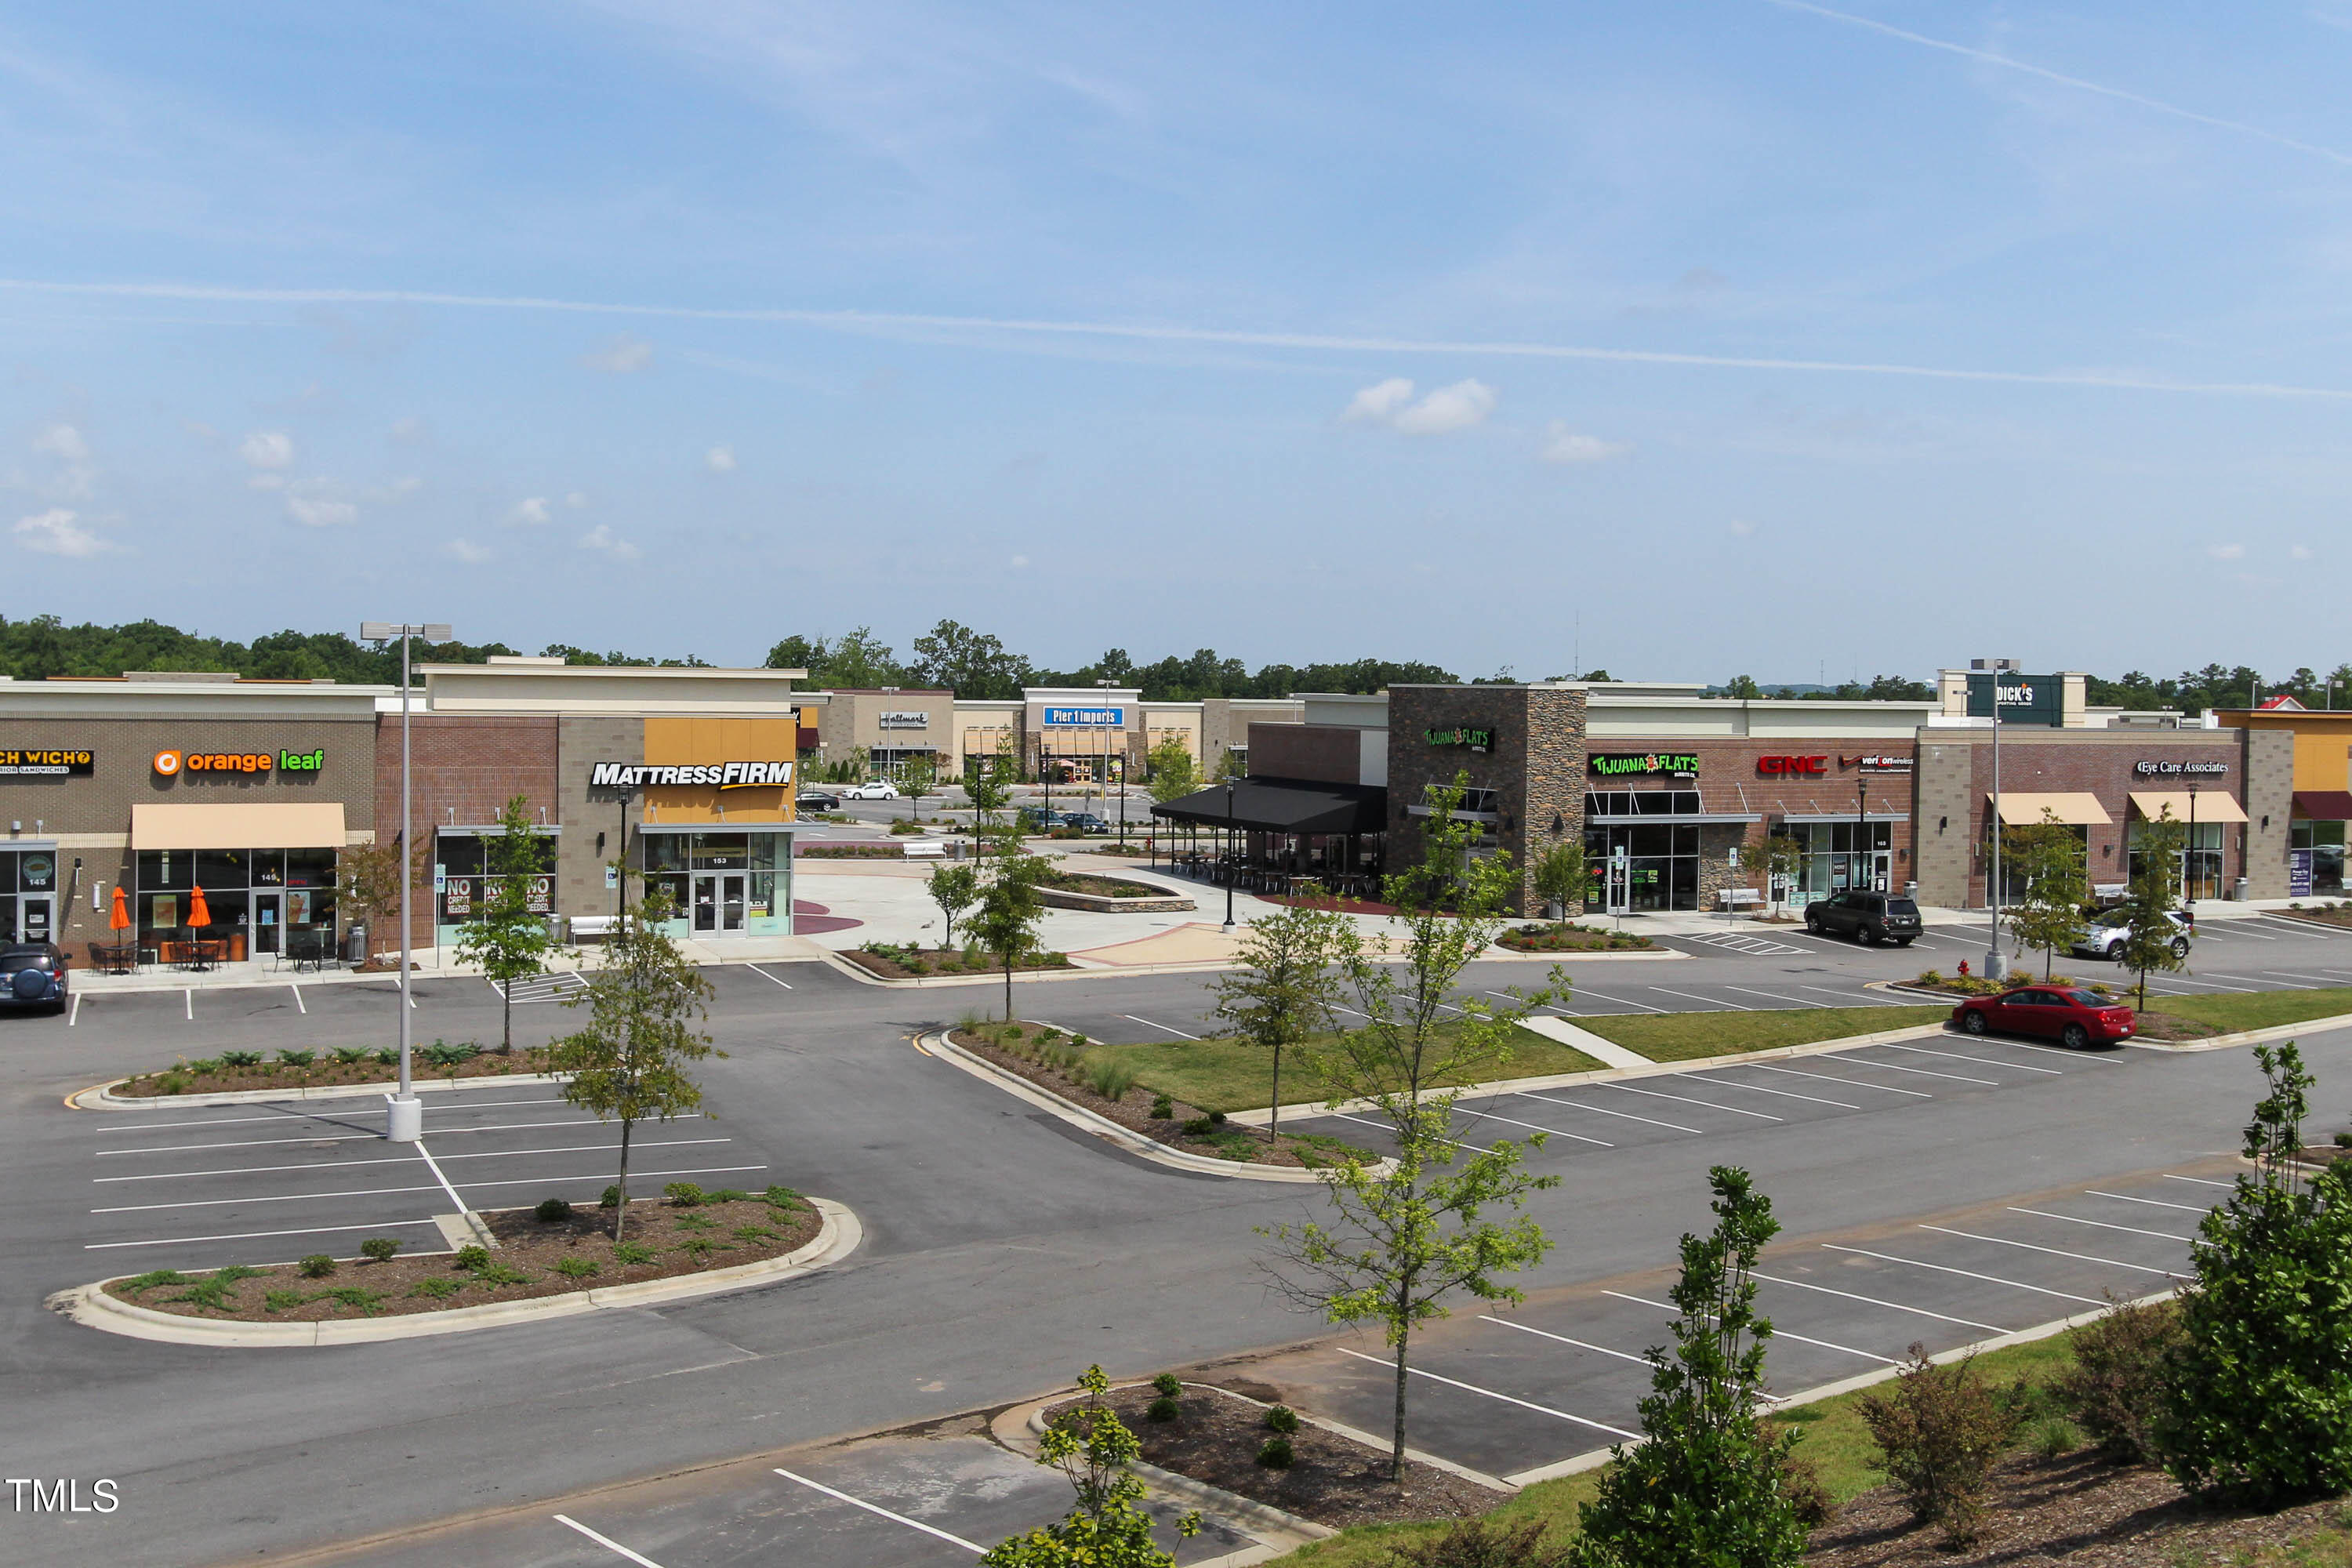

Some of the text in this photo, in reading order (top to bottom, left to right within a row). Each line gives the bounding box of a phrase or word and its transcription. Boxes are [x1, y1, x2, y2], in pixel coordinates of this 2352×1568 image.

[1997, 686, 2032, 702] DICK'S
[881, 713, 928, 724] Hallmark
[1053, 710, 1115, 724] Pier 1 Imports
[1424, 728, 1488, 746] TIJUANA FLATS
[187, 750, 324, 772] orange leaf
[1593, 755, 1699, 775] TIJUANA FLATS
[1759, 756, 1828, 774] GNC
[1862, 755, 1893, 767] verizon
[2141, 761, 2229, 775] Eye Care Associates
[448, 880, 470, 895] NO
[448, 905, 470, 914] NEEDED
